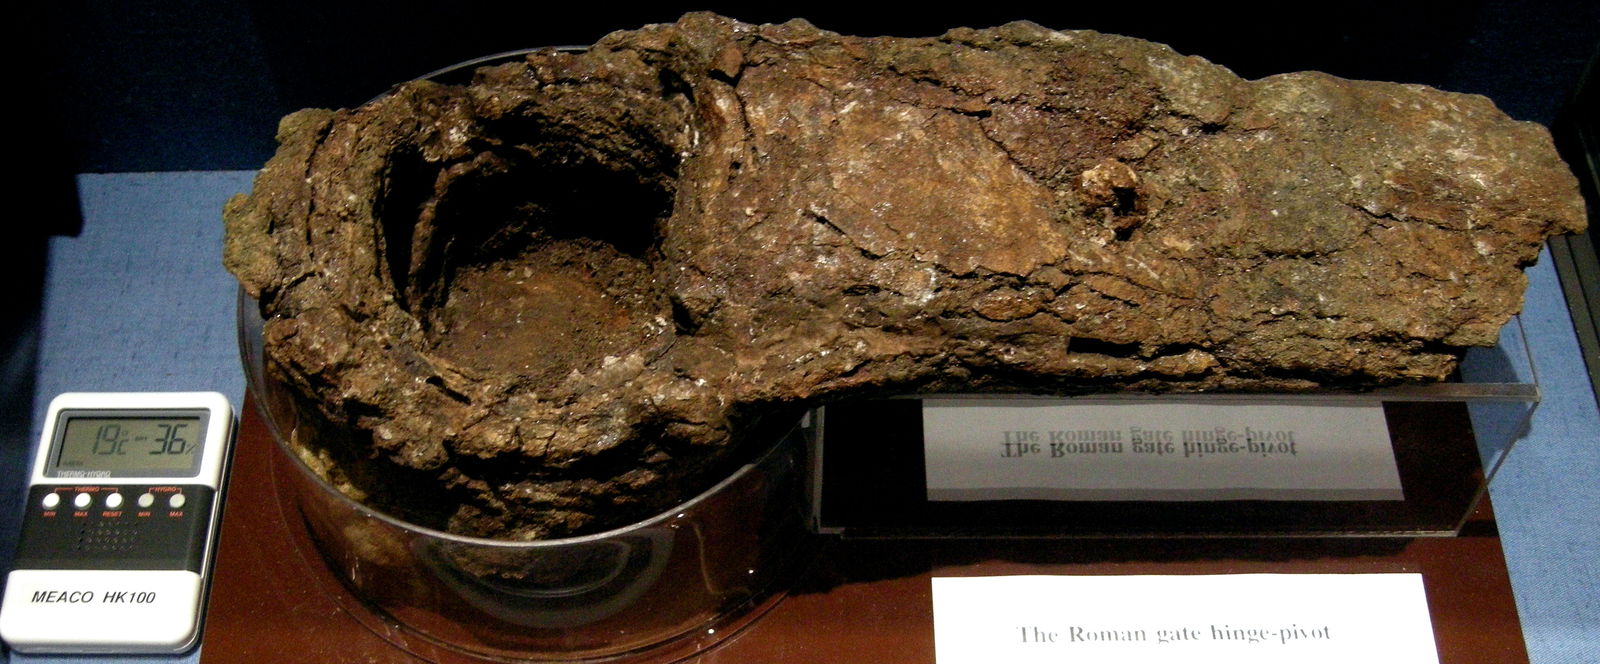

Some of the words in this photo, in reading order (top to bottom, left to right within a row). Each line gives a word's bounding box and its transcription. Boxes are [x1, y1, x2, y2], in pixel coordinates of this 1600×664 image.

[31, 590, 95, 604] MEACO
[102, 591, 157, 604] HK100
[1016, 626, 1059, 643] The
[1069, 626, 1147, 643] Roman
[1157, 626, 1201, 643] gate
[1211, 624, 1331, 645] hinge-pivot
